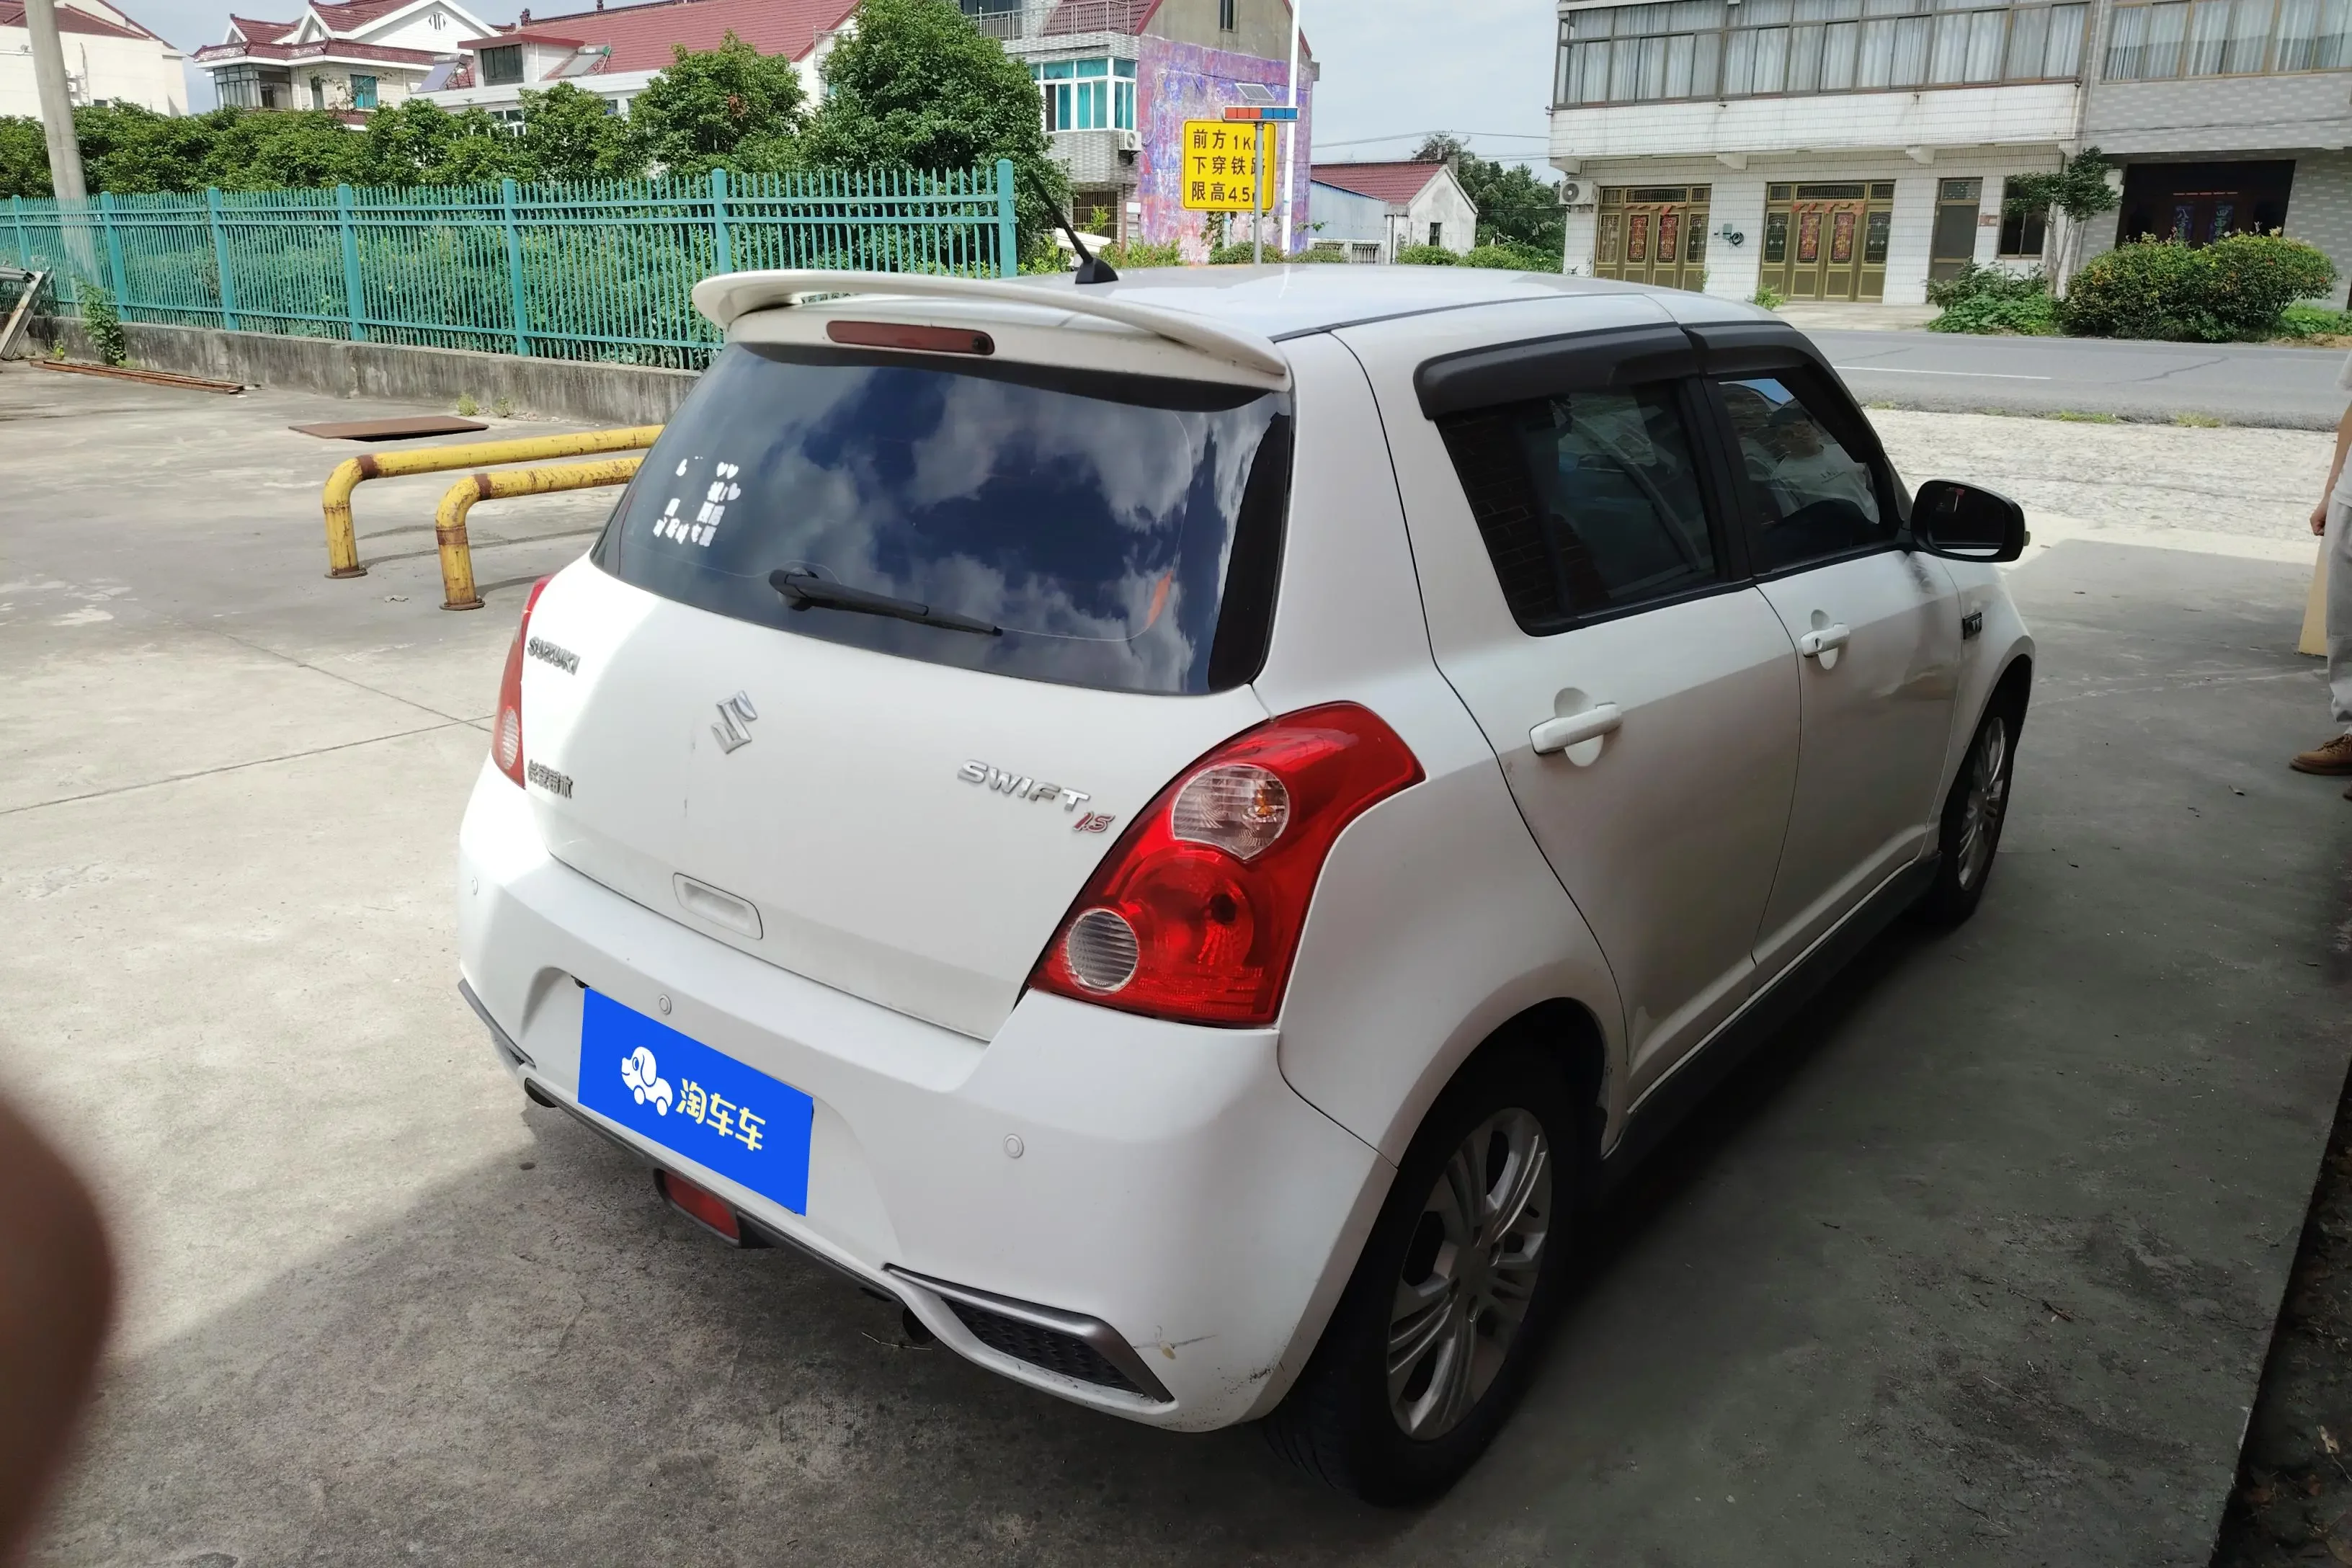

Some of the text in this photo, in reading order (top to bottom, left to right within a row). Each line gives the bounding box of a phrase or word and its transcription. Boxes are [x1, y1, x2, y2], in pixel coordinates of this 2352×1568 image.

[1192, 181, 1255, 202] 限高4.5
[527, 636, 581, 675] SUZUKI
[957, 759, 1091, 812] SWIFT
